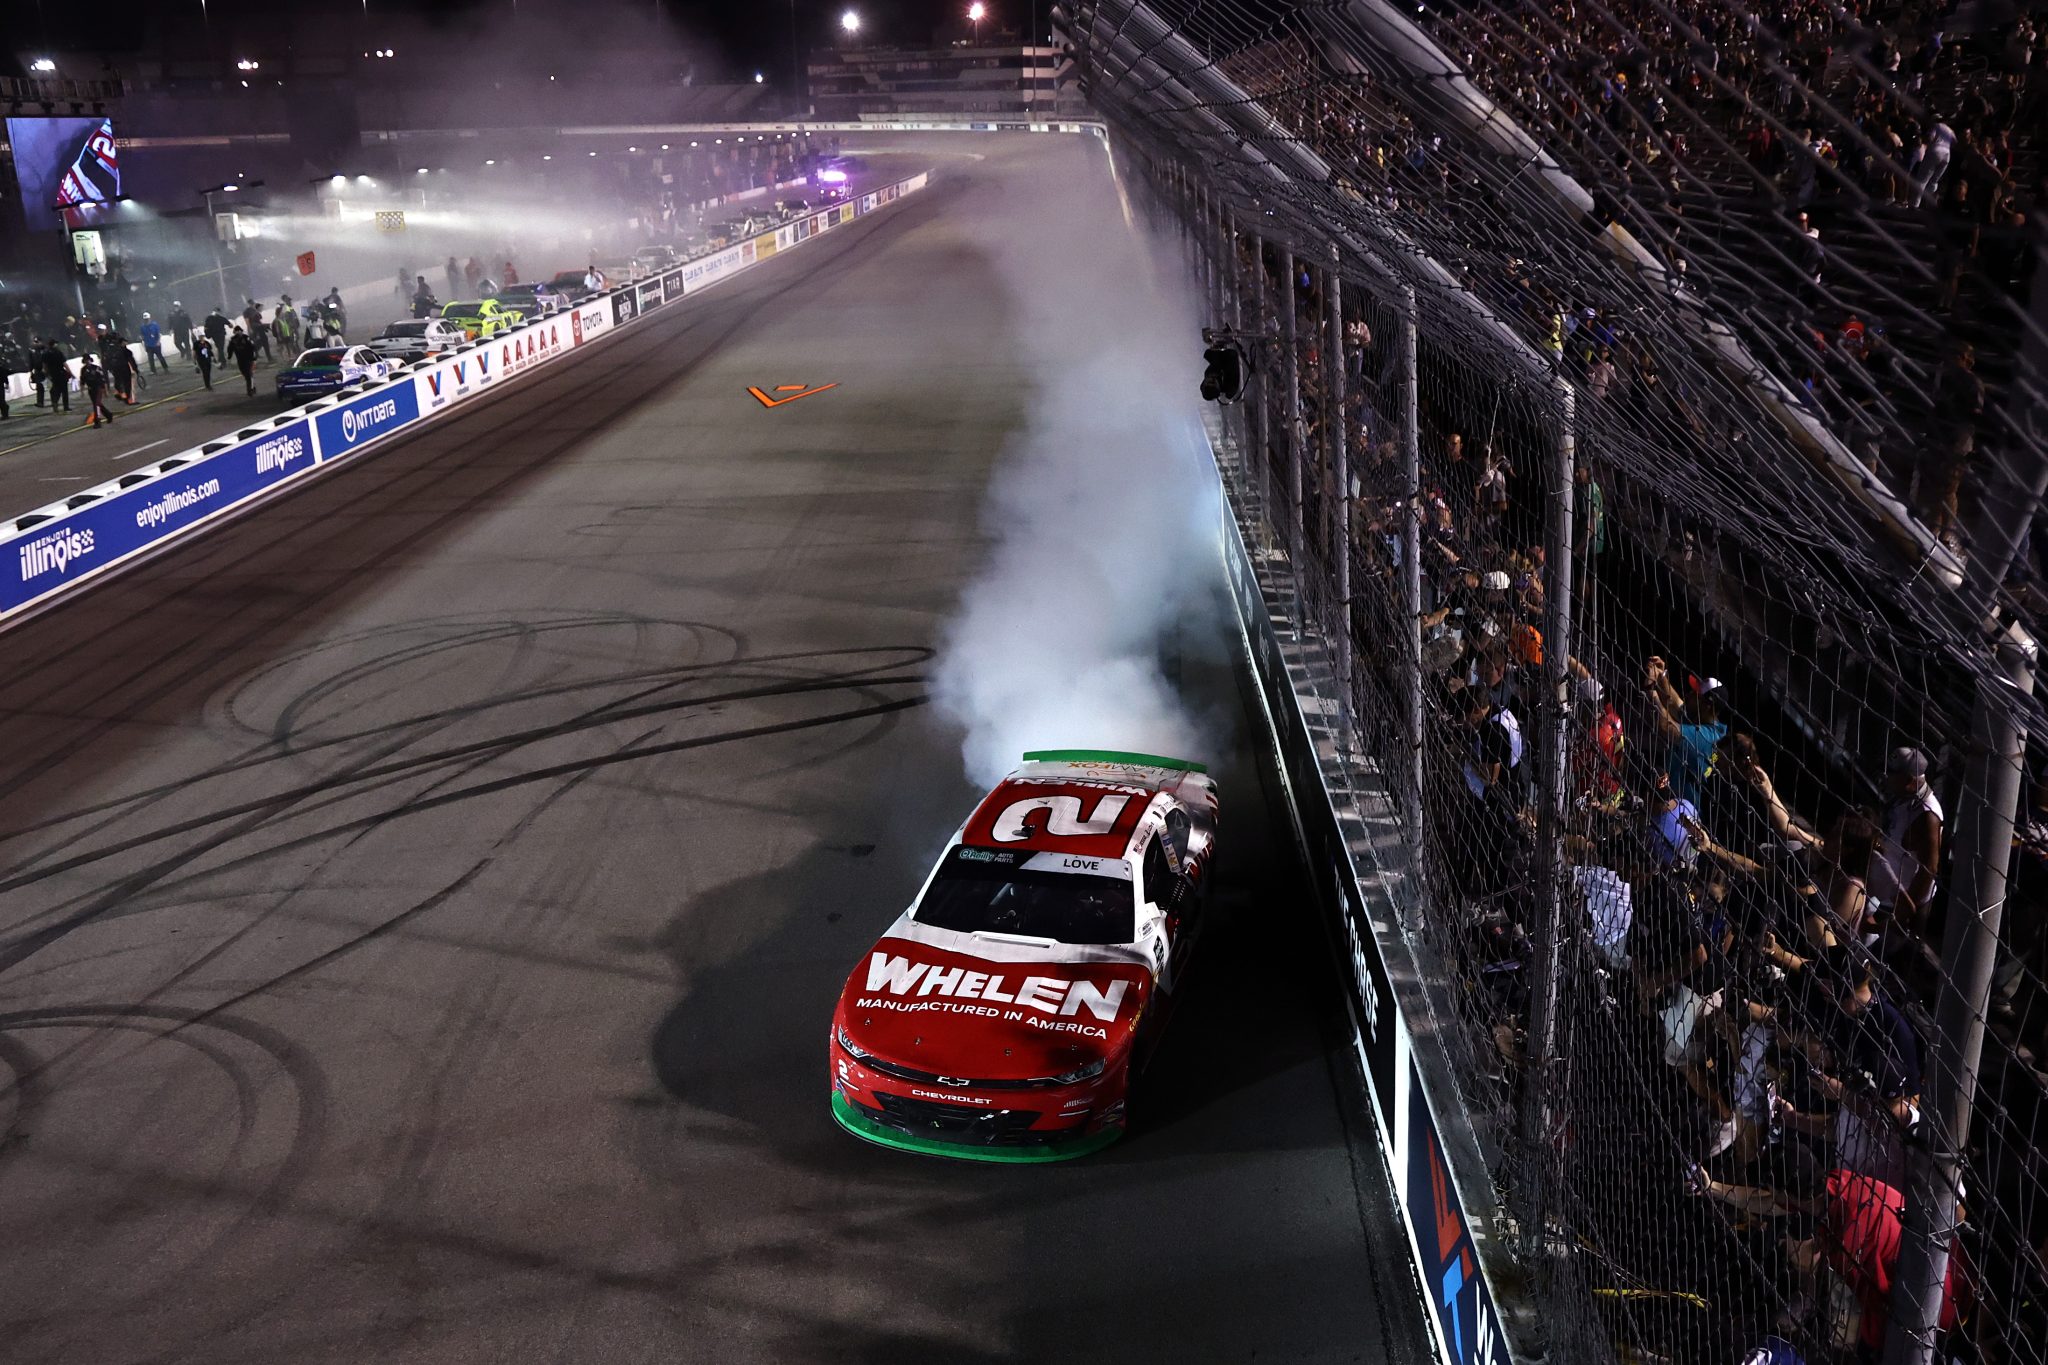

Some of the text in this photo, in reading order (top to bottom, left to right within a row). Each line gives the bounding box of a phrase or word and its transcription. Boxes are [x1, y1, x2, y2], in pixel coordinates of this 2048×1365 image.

[92, 136, 116, 160] 2
[582, 311, 603, 331] TOYOTA
[356, 406, 374, 431] NTT
[136, 478, 220, 528] enjoyillinois.com
[41, 528, 65, 547] ENJOY
[1014, 778, 1148, 797] WHELEN
[992, 794, 1131, 843] 2
[1063, 858, 1100, 871] LOVE
[866, 952, 1129, 1023] WHELEN
[856, 998, 1107, 1040] MANUFACTURED IN AMERICA
[838, 1059, 850, 1081] 2
[912, 1089, 993, 1105] CHEVROLET
